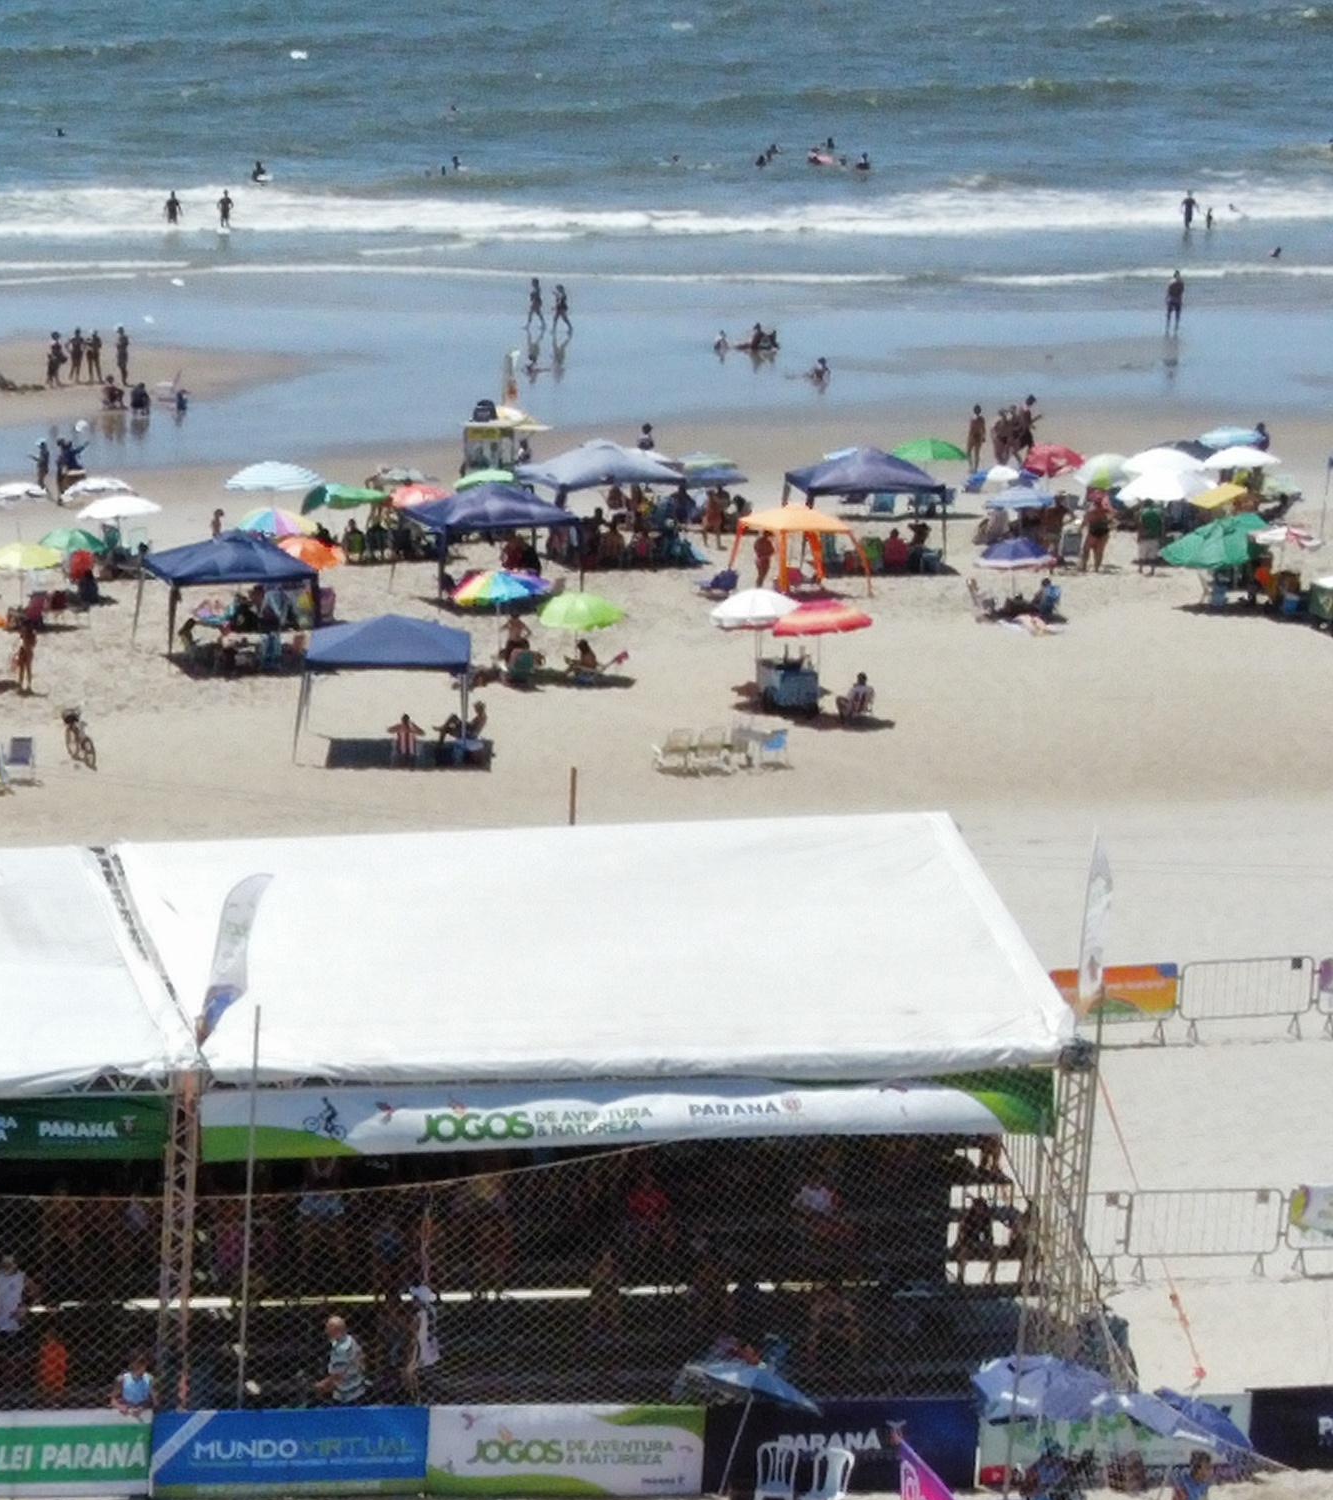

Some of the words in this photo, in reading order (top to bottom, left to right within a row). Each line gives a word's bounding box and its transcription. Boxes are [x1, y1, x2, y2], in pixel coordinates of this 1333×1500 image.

[417, 1111, 535, 1144] JOGOS
[536, 1111, 558, 1124] DE
[41, 1434, 146, 1469] PARANÁ
[192, 1439, 299, 1460] MUNDO
[467, 1439, 564, 1465] JOGOS
[566, 1441, 586, 1451] DE
[589, 1440, 674, 1451] AVENTURA
[579, 1453, 663, 1466] NATUREZA
